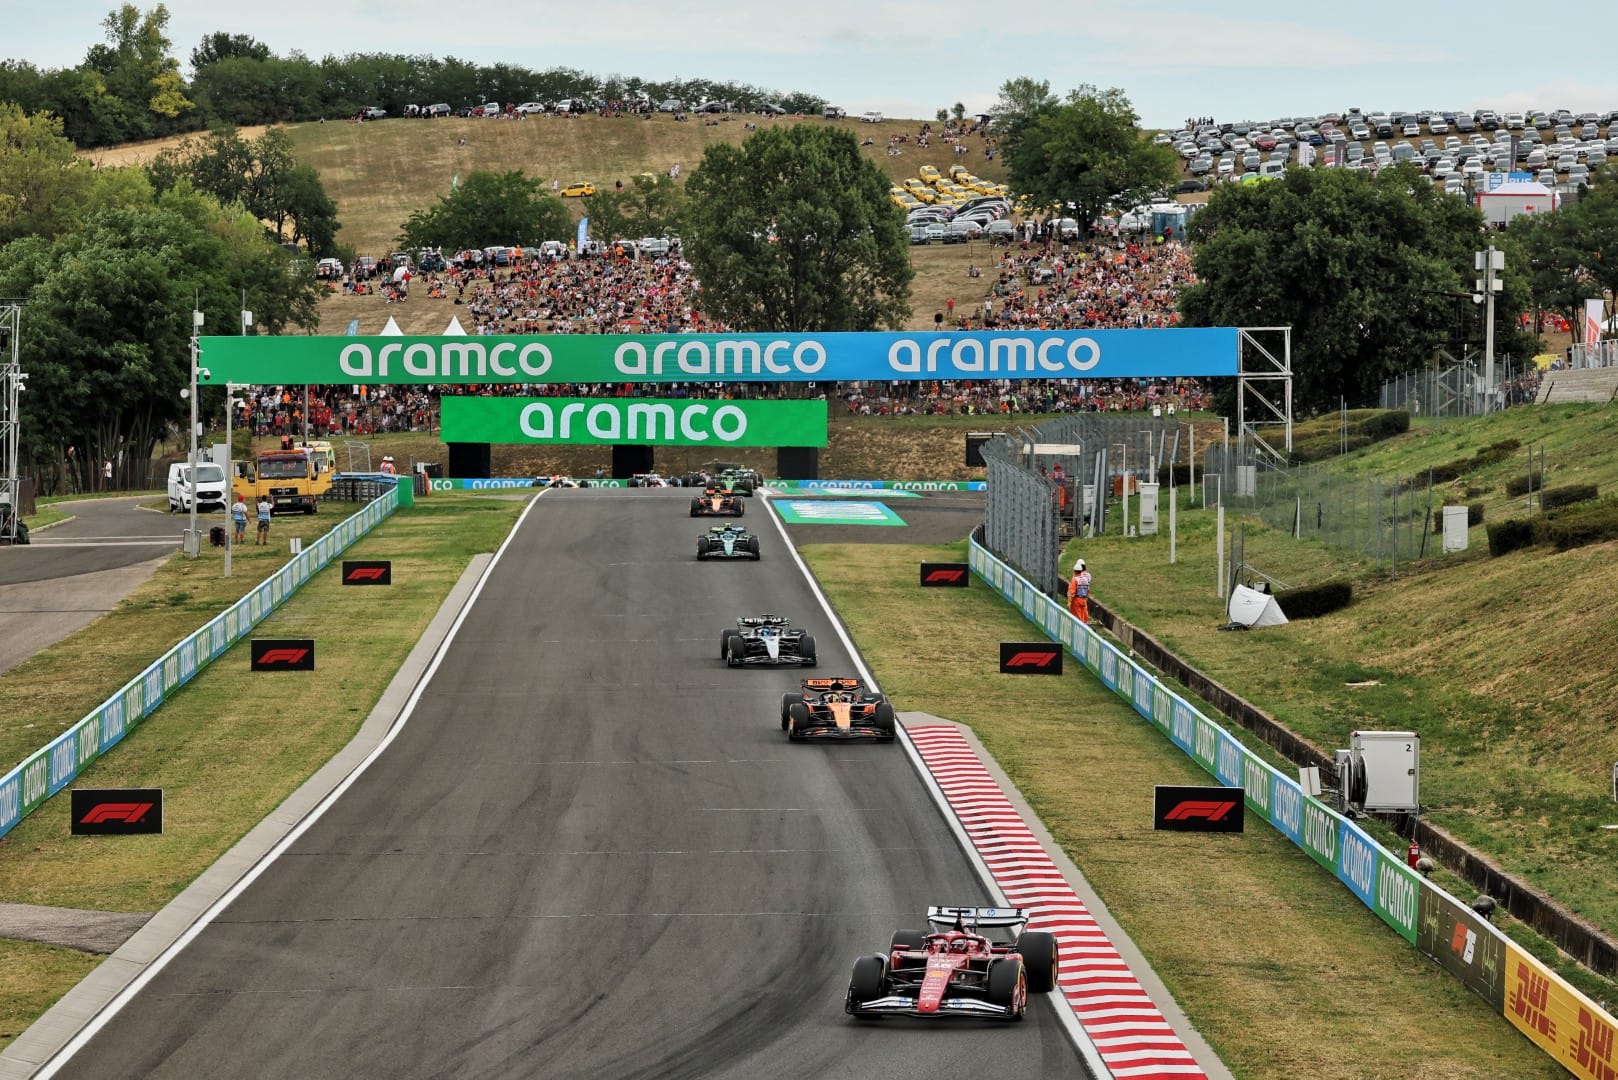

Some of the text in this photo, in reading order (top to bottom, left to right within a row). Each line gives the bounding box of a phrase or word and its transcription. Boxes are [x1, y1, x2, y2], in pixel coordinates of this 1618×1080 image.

[339, 342, 553, 376] aramco
[614, 340, 827, 375] aramco
[888, 337, 1101, 372] aramco
[519, 402, 747, 441] aramco
[1405, 743, 1413, 752] 2
[1275, 780, 1300, 835] aramco
[1304, 803, 1335, 862] aramco
[1343, 830, 1373, 895] aramco
[1379, 861, 1415, 931] aramco
